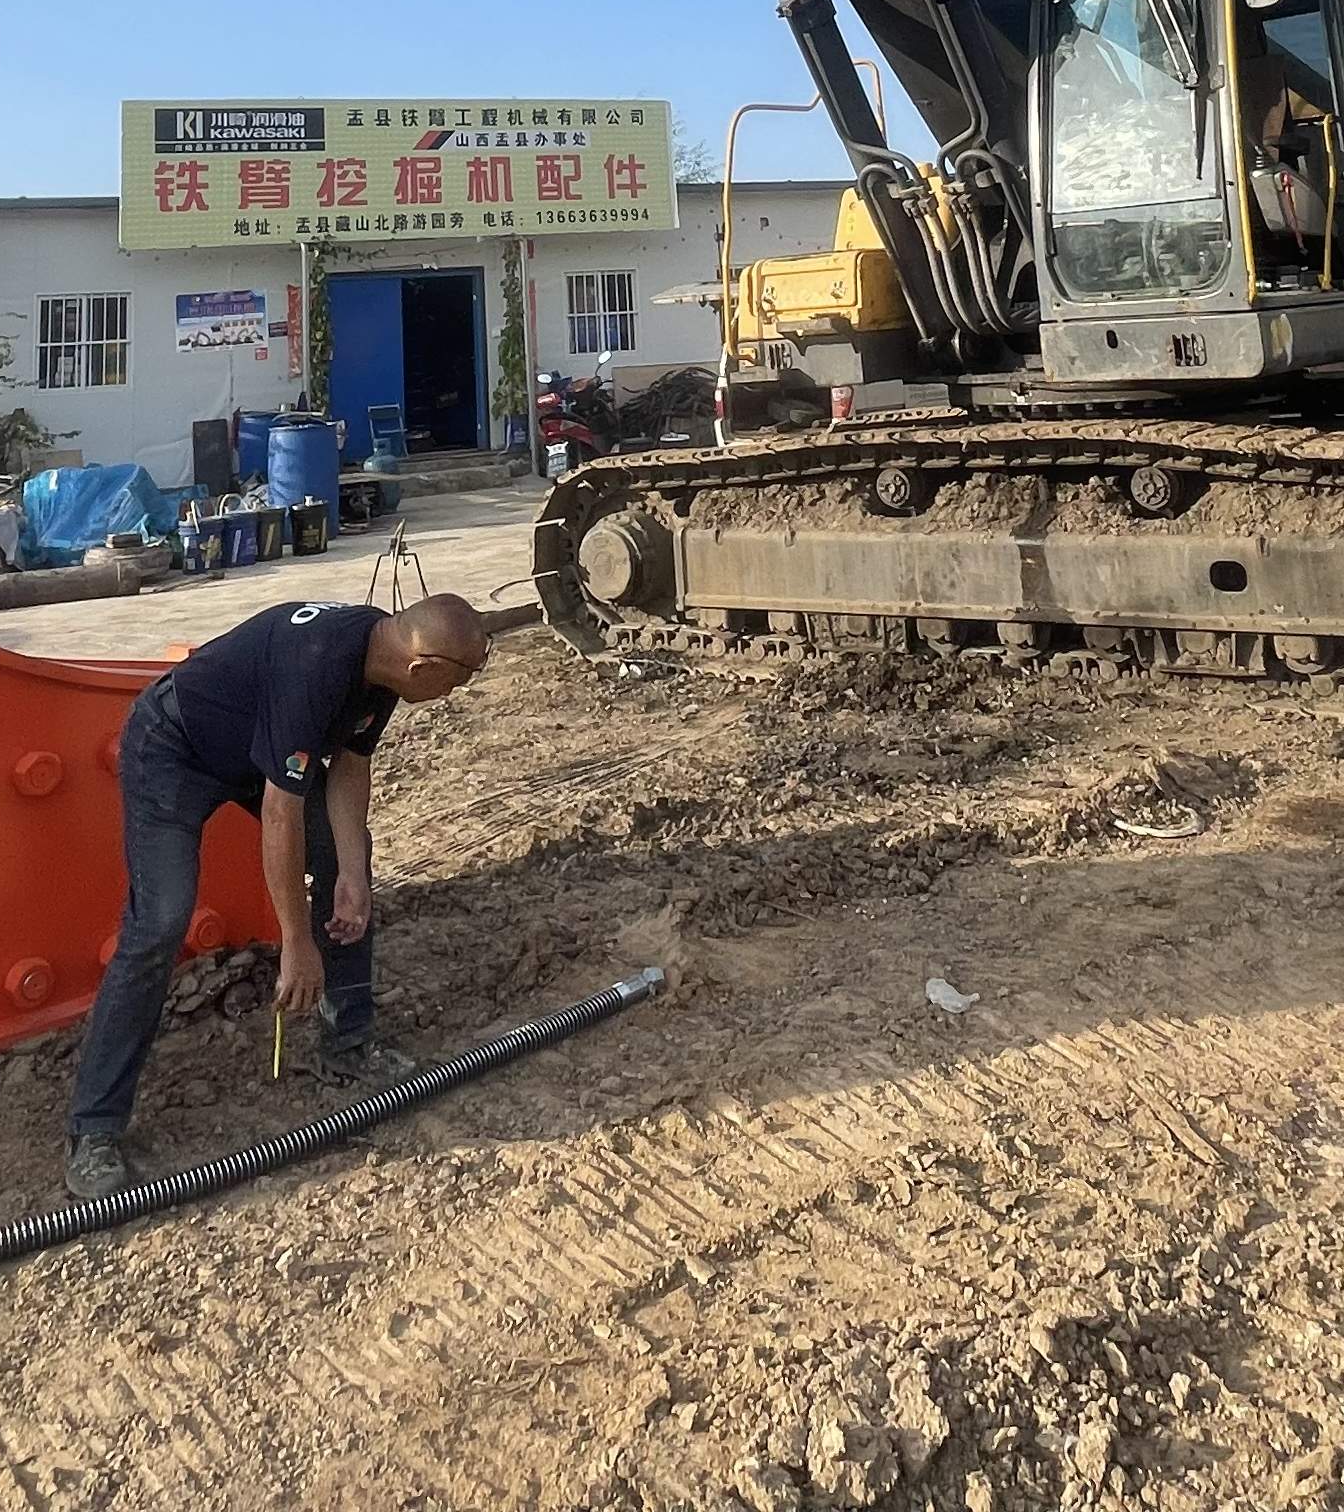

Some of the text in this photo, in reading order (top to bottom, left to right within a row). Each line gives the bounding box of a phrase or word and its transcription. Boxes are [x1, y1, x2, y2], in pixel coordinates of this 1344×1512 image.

[154, 153, 648, 213] 铁臂挖掘机配件
[536, 207, 650, 226] 13663639994
